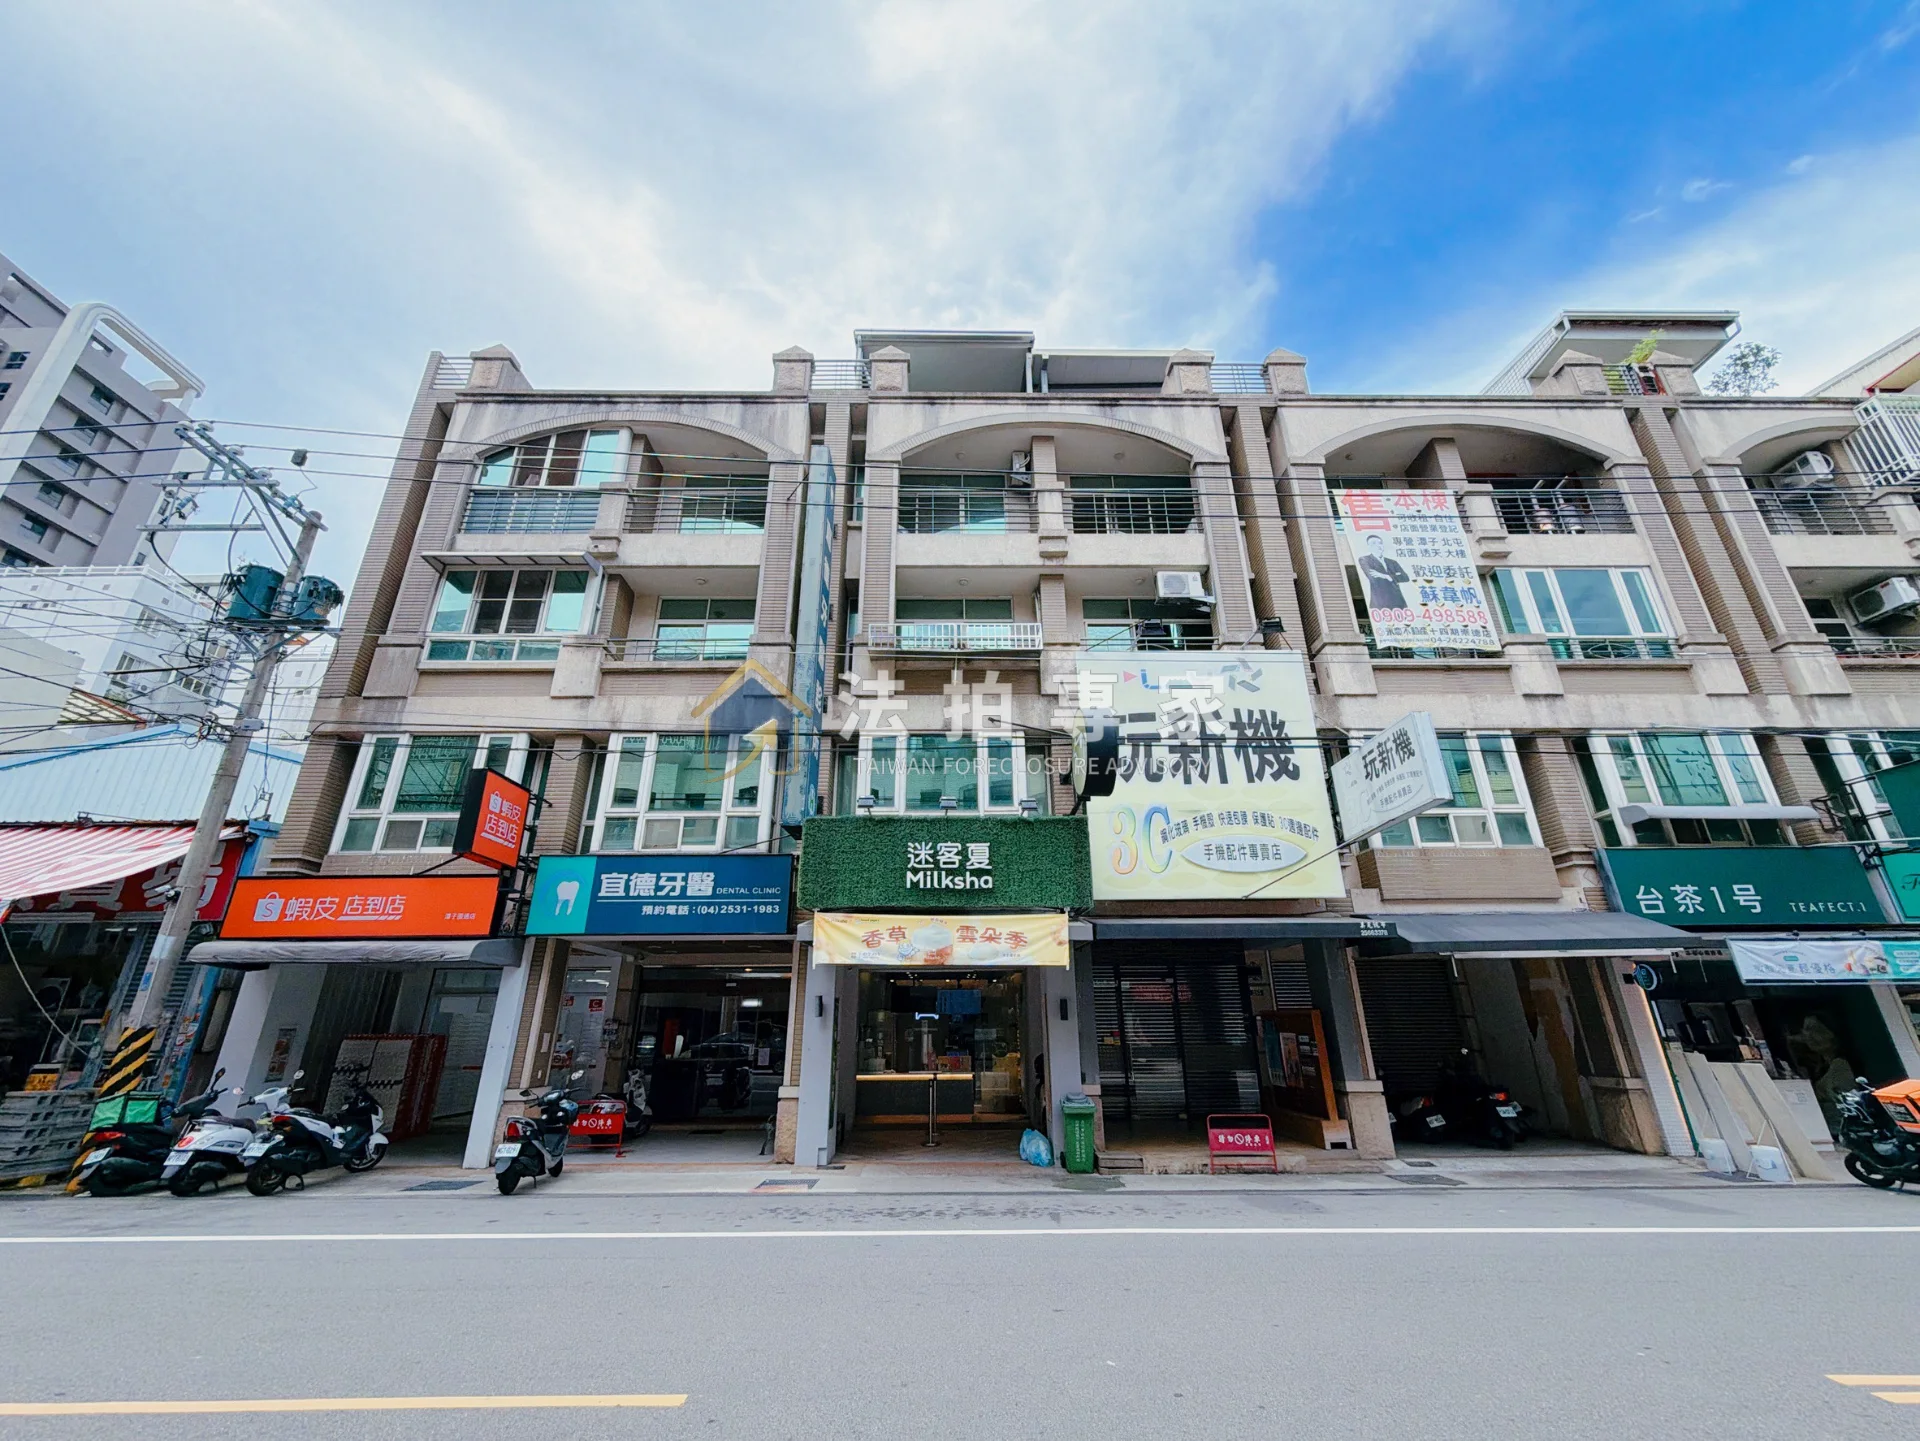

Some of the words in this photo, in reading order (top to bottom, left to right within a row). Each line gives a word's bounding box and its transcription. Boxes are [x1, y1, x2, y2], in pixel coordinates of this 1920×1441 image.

[1340, 488, 1392, 532] 售
[1394, 490, 1450, 511] 本棟
[1396, 548, 1418, 558] 店面
[1412, 565, 1473, 579] 歡迎委託
[1371, 607, 1489, 626] 0909-498588
[1430, 636, 1496, 647] 04-24224788
[1362, 727, 1416, 781] 玩新機
[501, 799, 522, 823] 蝦皮
[484, 813, 518, 843] 店到店
[1112, 806, 1173, 875] 3C
[1203, 843, 1284, 861] 手機配件專賣店
[907, 841, 993, 870] 迷客夏
[597, 871, 716, 897] 宜德牙醫
[716, 887, 750, 895] DENTAL
[752, 886, 782, 894] CLINIC
[906, 870, 994, 890] Milksha
[283, 896, 340, 922] 蝦皮
[342, 894, 407, 915] 店到店
[1635, 884, 1763, 914] 台茶1号
[1788, 901, 1868, 914] TEAFECT.1
[861, 925, 908, 949] 香草
[955, 925, 1029, 950] 雲朵季
